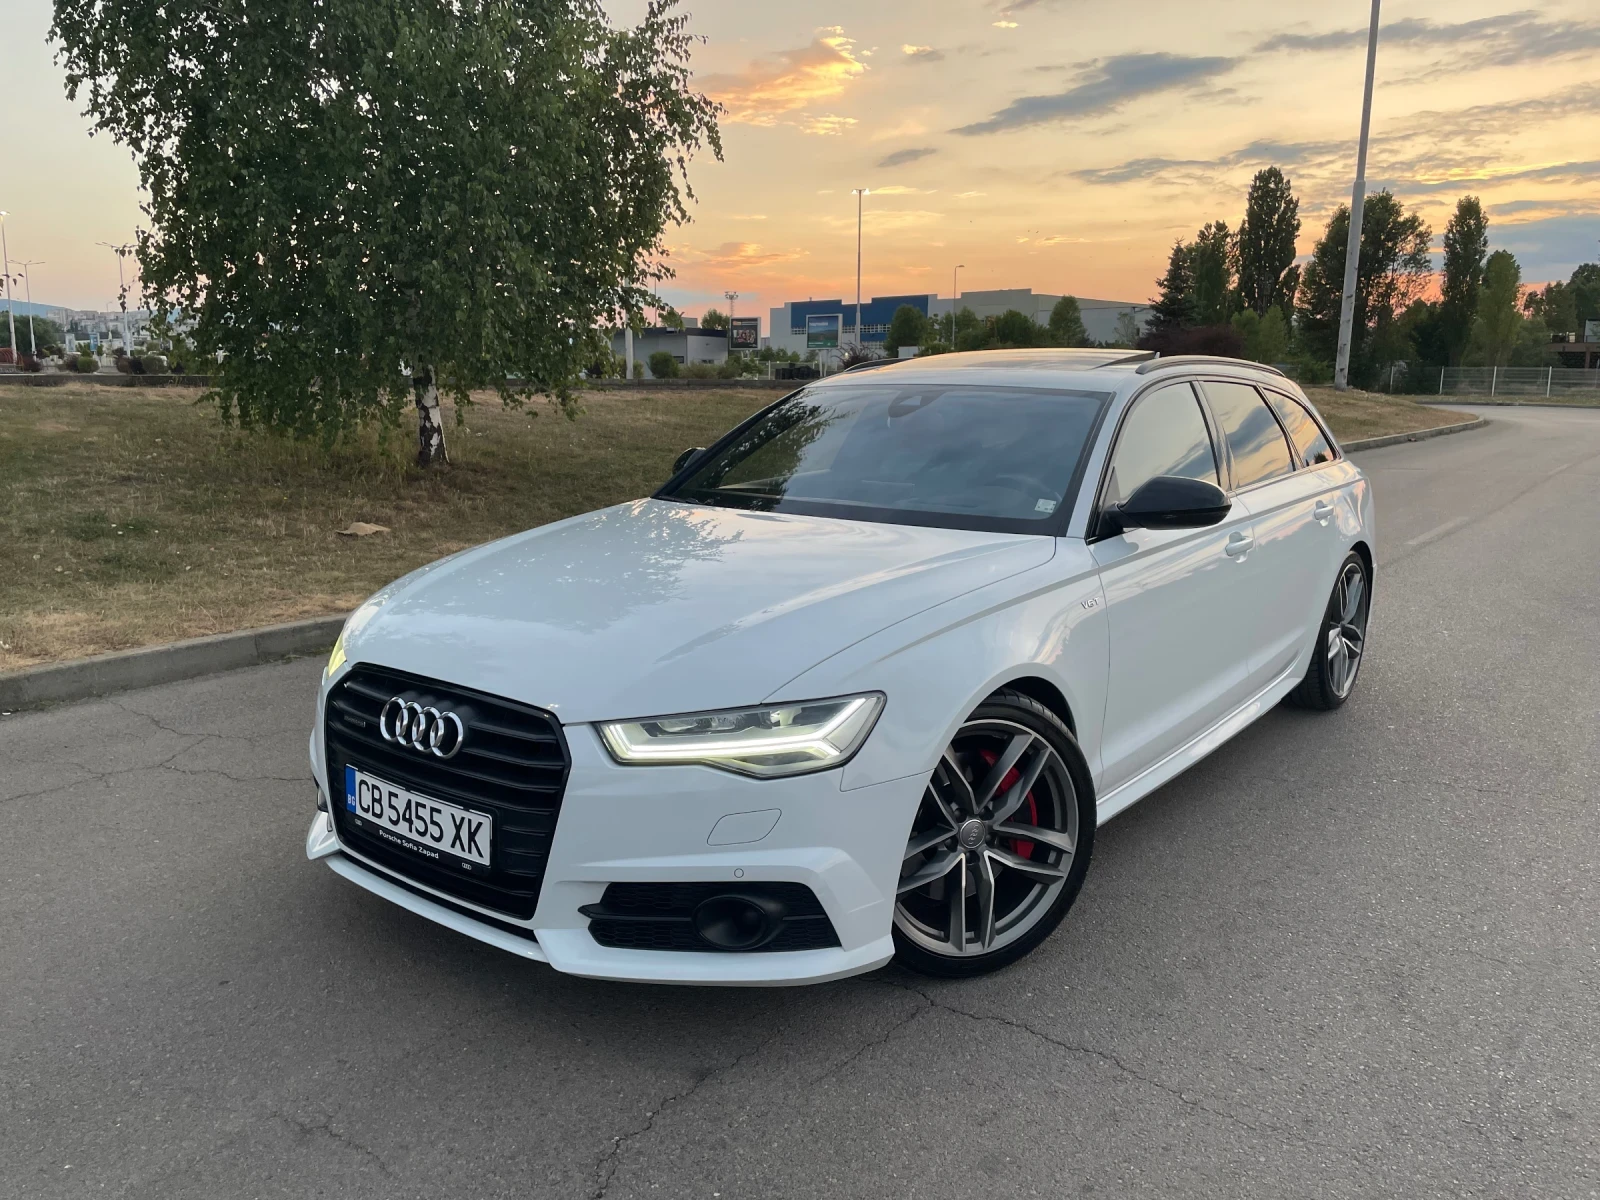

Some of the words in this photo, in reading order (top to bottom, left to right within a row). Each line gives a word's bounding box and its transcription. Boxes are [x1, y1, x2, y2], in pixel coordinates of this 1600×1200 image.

[347, 794, 356, 806] BG
[358, 779, 384, 819] CB
[388, 790, 444, 843] 5455
[450, 812, 484, 859] XK
[379, 829, 402, 845] Porsche
[402, 839, 418, 851] Sofia
[418, 846, 439, 859] Zapad
